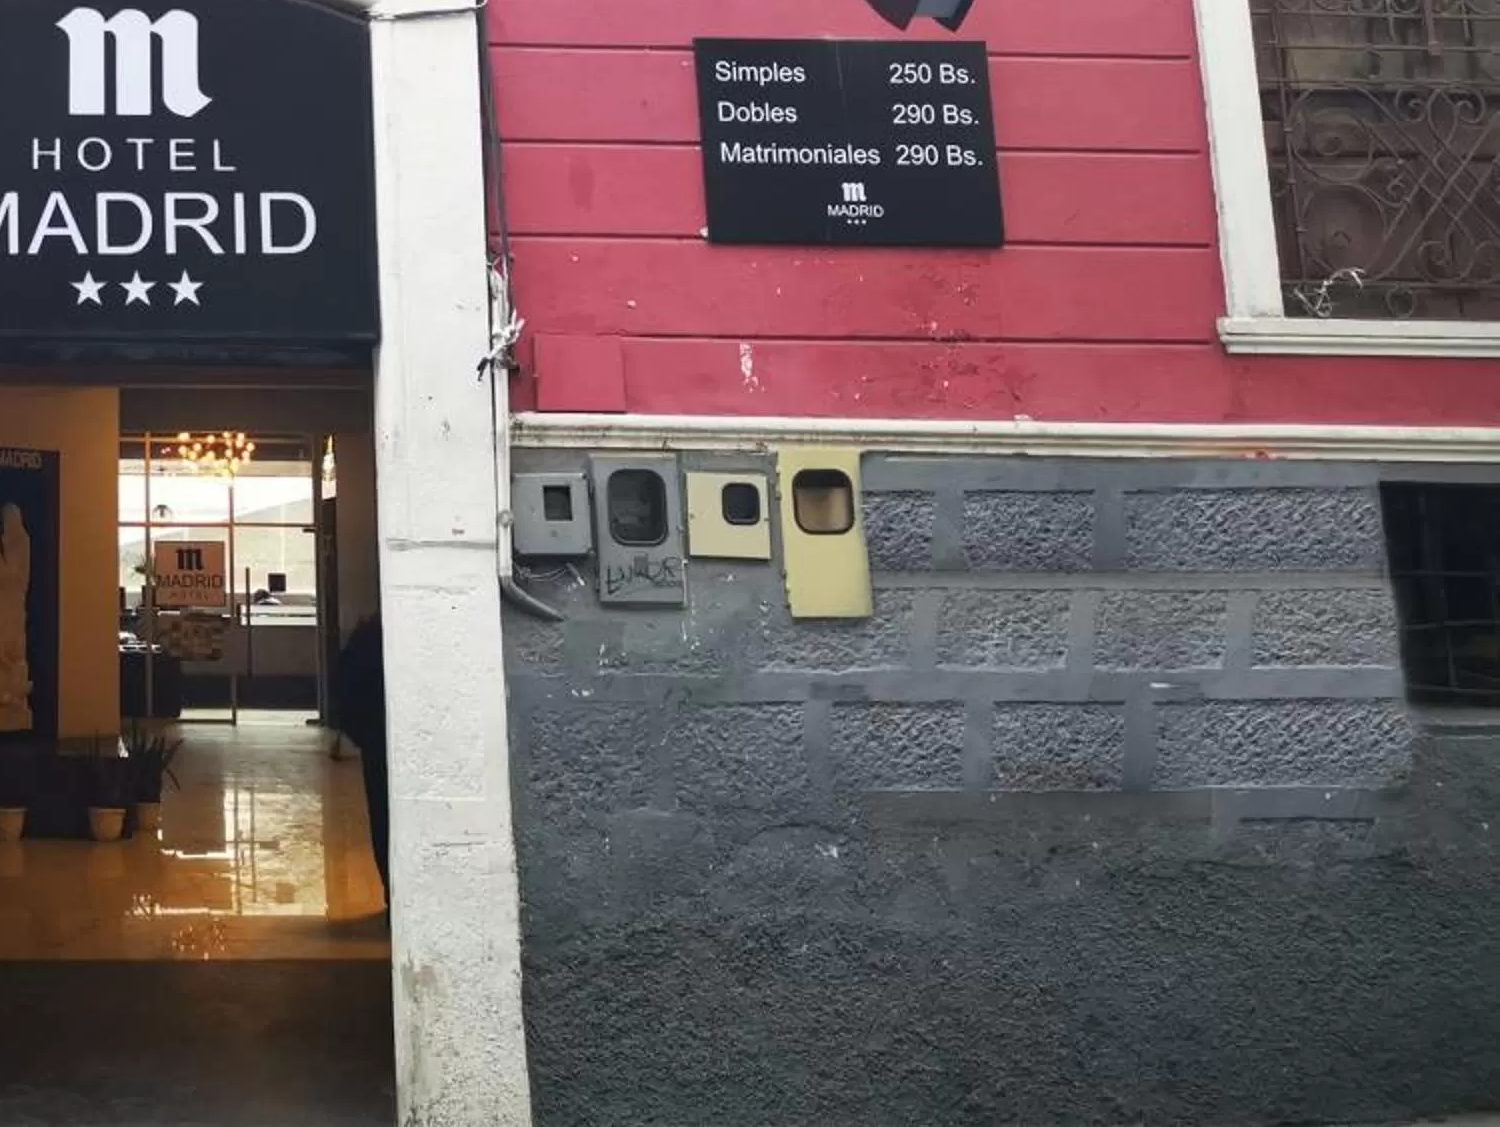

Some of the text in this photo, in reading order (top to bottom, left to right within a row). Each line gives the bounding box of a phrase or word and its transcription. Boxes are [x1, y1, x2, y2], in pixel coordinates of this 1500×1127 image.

[54, 6, 213, 118] m
[715, 60, 977, 86] Simples 250 Bs.
[717, 101, 980, 125] Dobles 290 Bs.
[31, 136, 237, 172] HOTEL
[720, 142, 984, 166] Matrimoniales 290 Bs.
[827, 204, 885, 218] MADRID
[156, 574, 224, 589] MADRID
